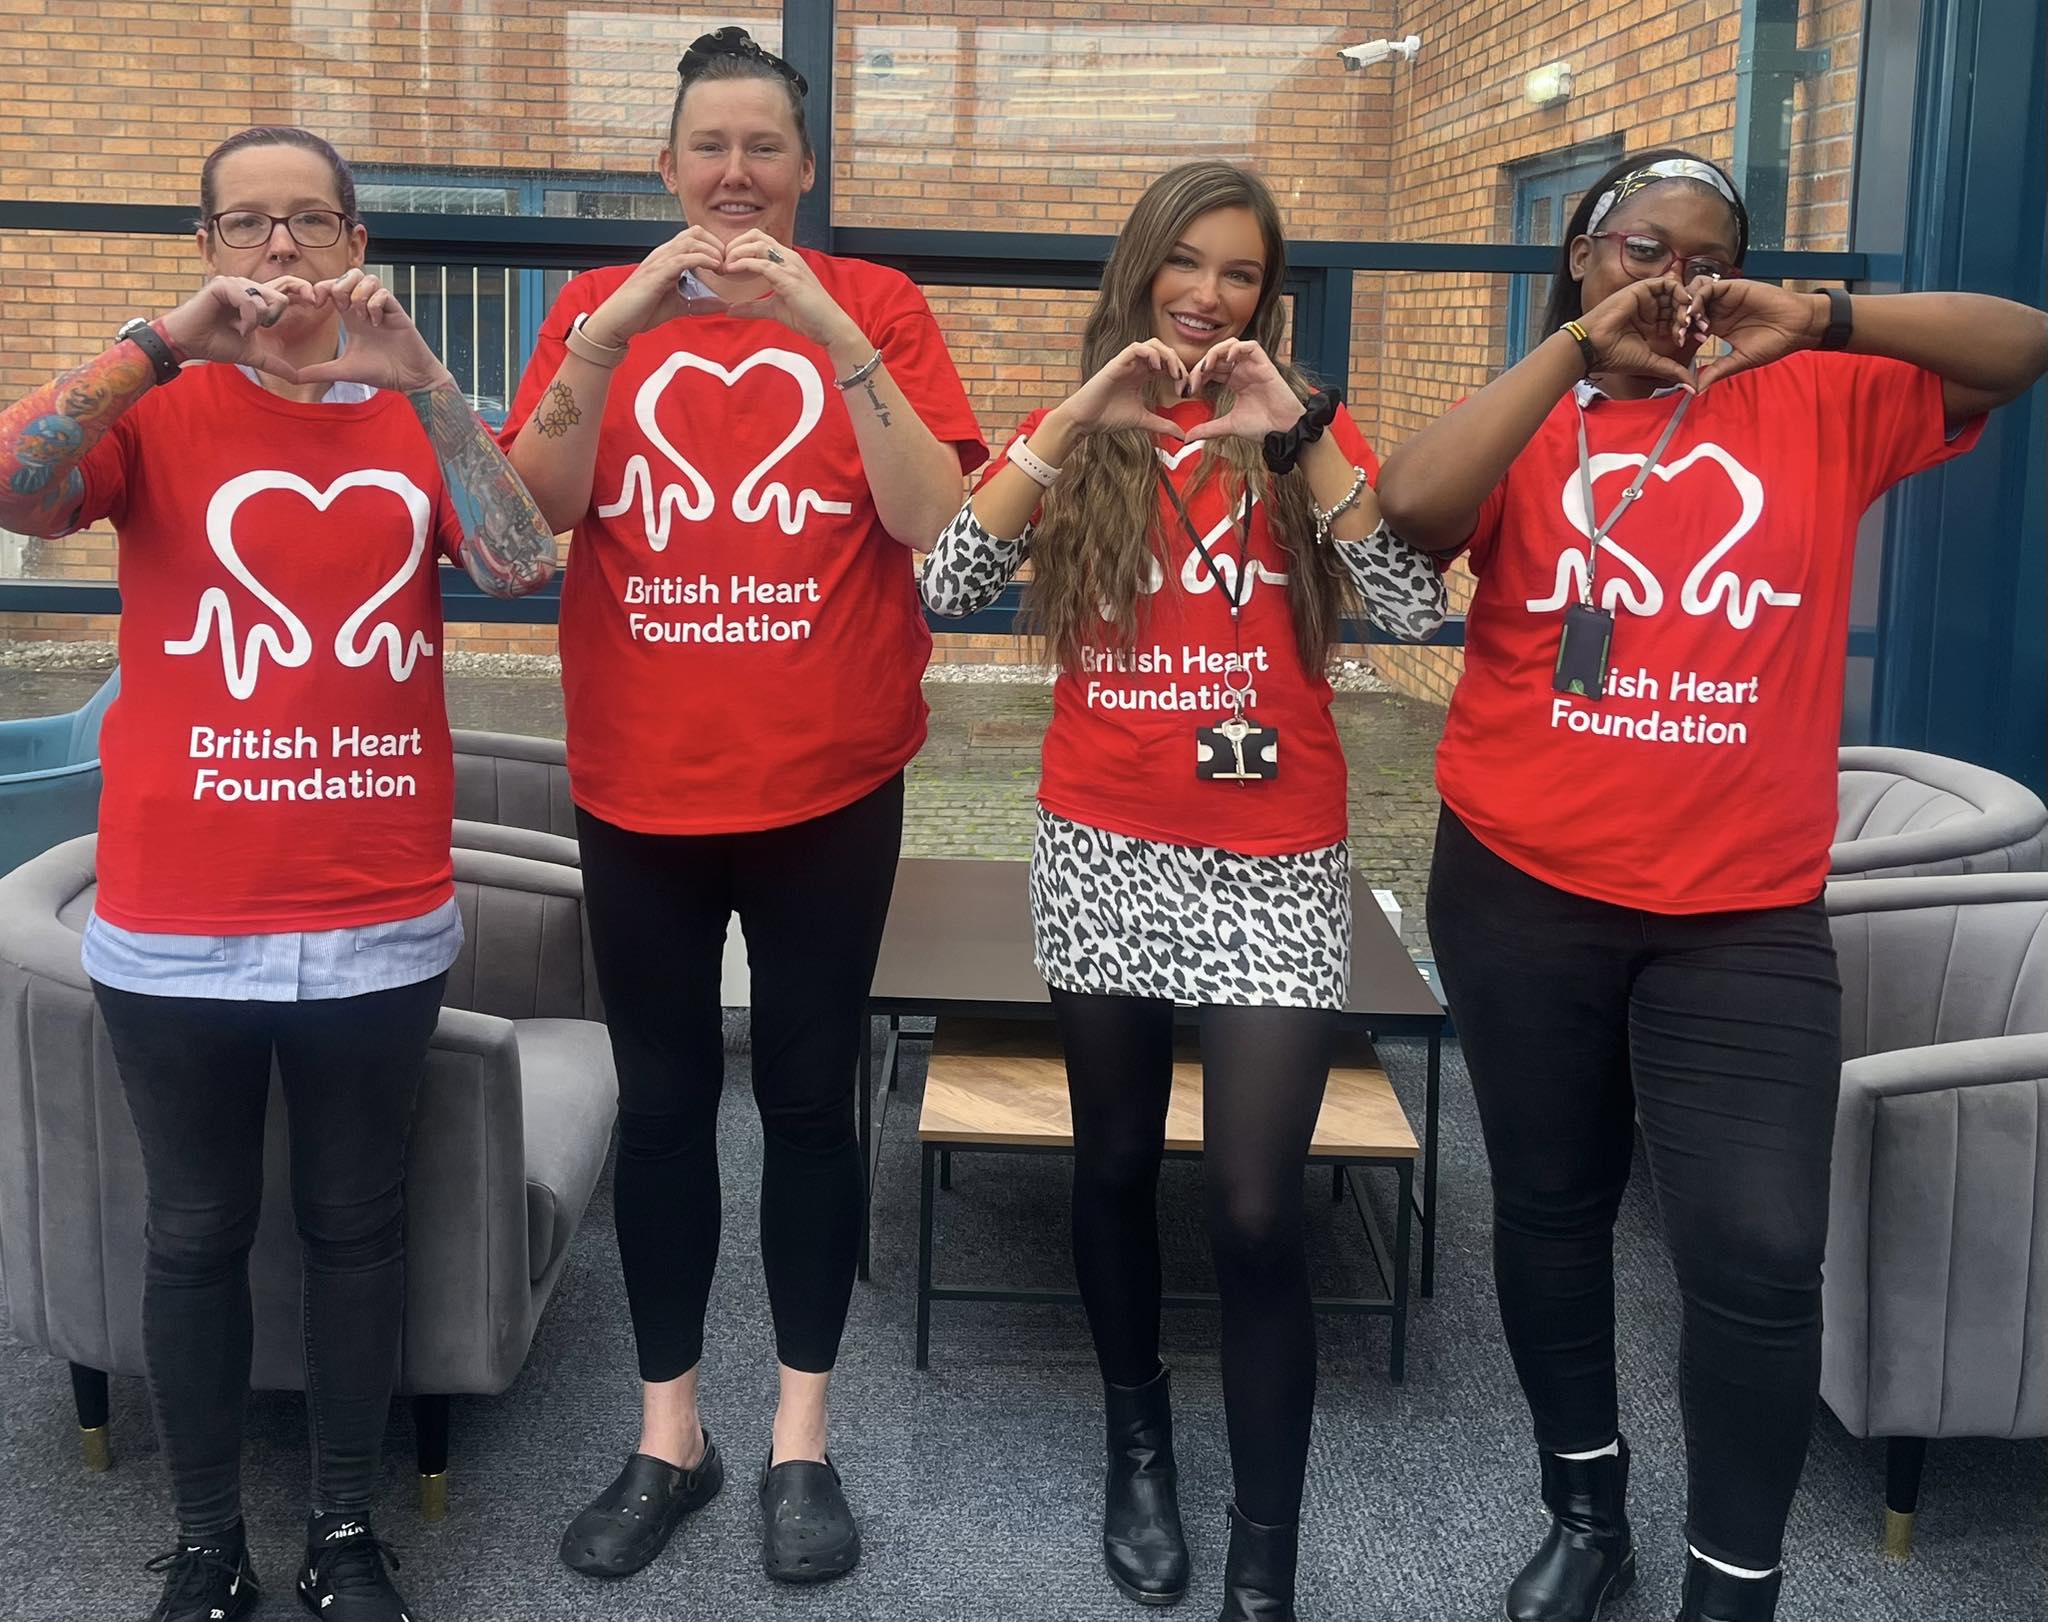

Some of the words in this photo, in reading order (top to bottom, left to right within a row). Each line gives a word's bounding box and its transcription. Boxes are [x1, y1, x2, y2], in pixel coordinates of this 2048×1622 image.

[623, 574, 720, 605] British
[730, 575, 822, 604] Heart
[629, 612, 811, 643] Foundation
[1182, 645, 1270, 674] Heart
[1087, 680, 1258, 711] Foundation
[1669, 671, 1759, 704] Heart
[1551, 698, 1747, 745] Foundation
[189, 725, 318, 760] British
[331, 725, 423, 758] Heart
[193, 767, 416, 802] Foundation
